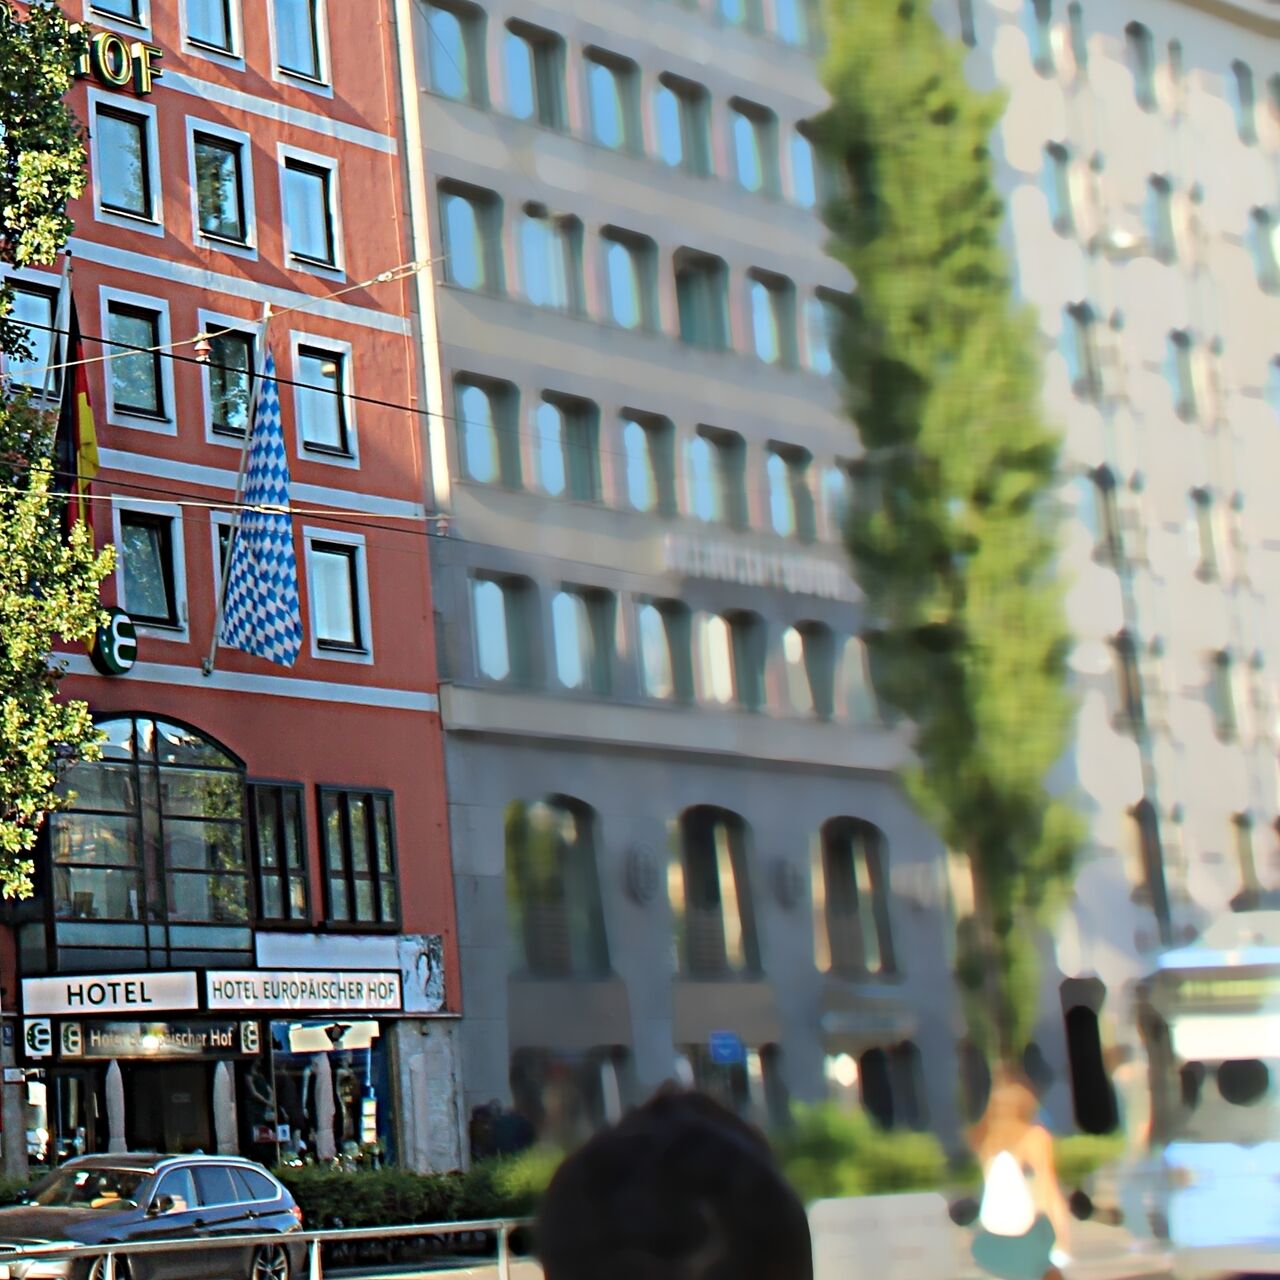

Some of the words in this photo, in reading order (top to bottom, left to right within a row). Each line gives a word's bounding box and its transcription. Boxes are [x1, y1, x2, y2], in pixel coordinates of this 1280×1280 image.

[66, 981, 153, 1007] HOTEL
[212, 979, 258, 1001] HOTEL
[263, 977, 365, 1001] EUROPÄISCHER
[368, 980, 396, 1002] HOF
[210, 1027, 235, 1047] Hof
